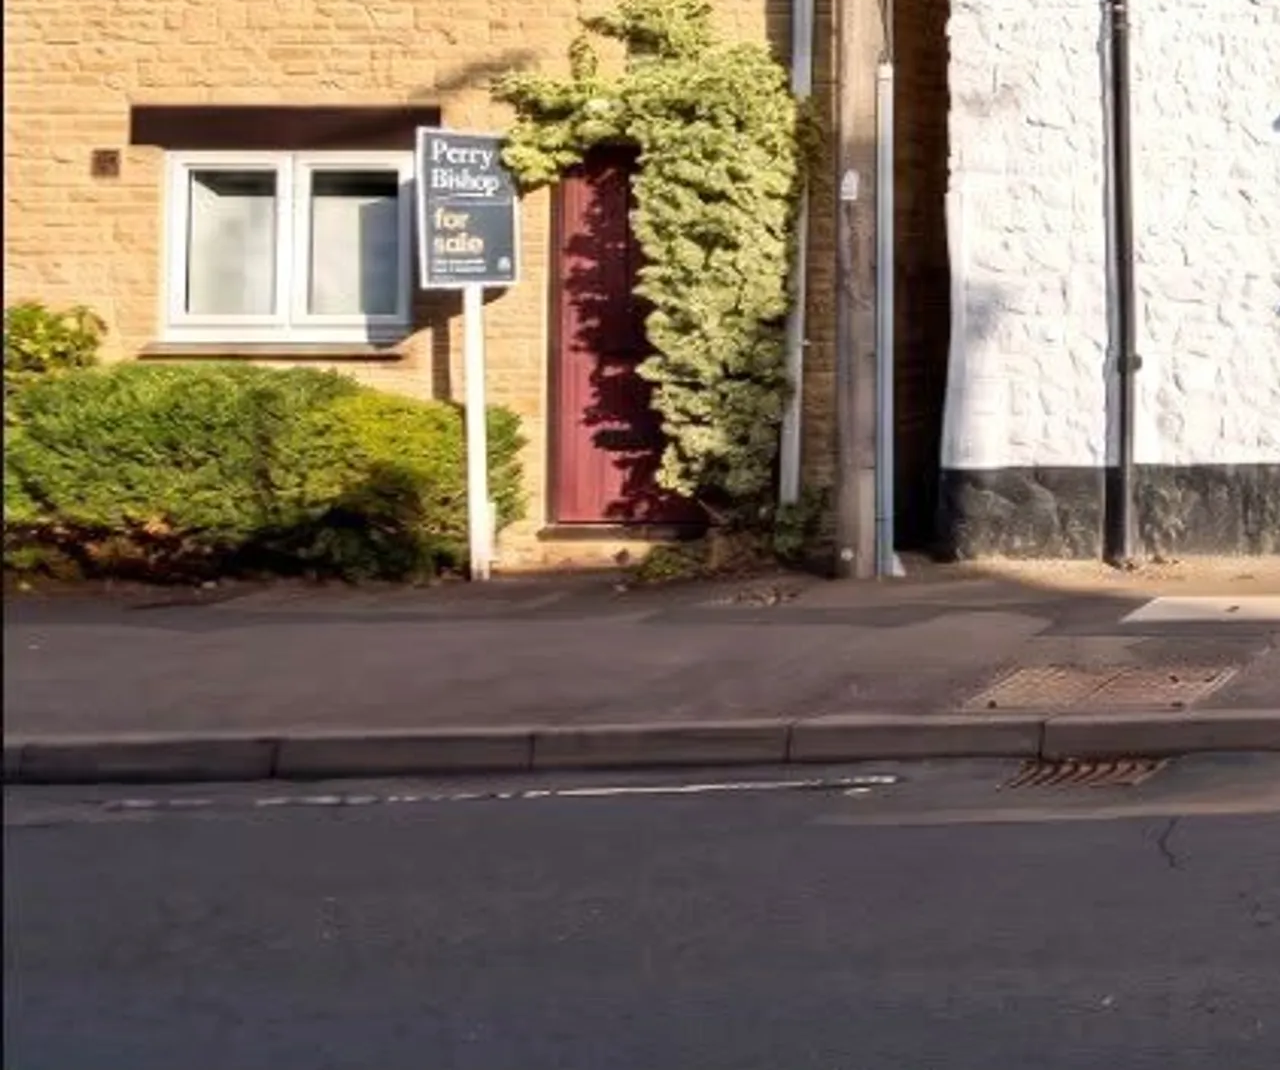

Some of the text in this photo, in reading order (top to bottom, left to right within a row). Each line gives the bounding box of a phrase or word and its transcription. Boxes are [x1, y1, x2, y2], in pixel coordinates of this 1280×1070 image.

[431, 137, 493, 170] Perry
[431, 168, 500, 197] Bishop
[434, 207, 469, 230] for
[433, 232, 484, 251] sale
